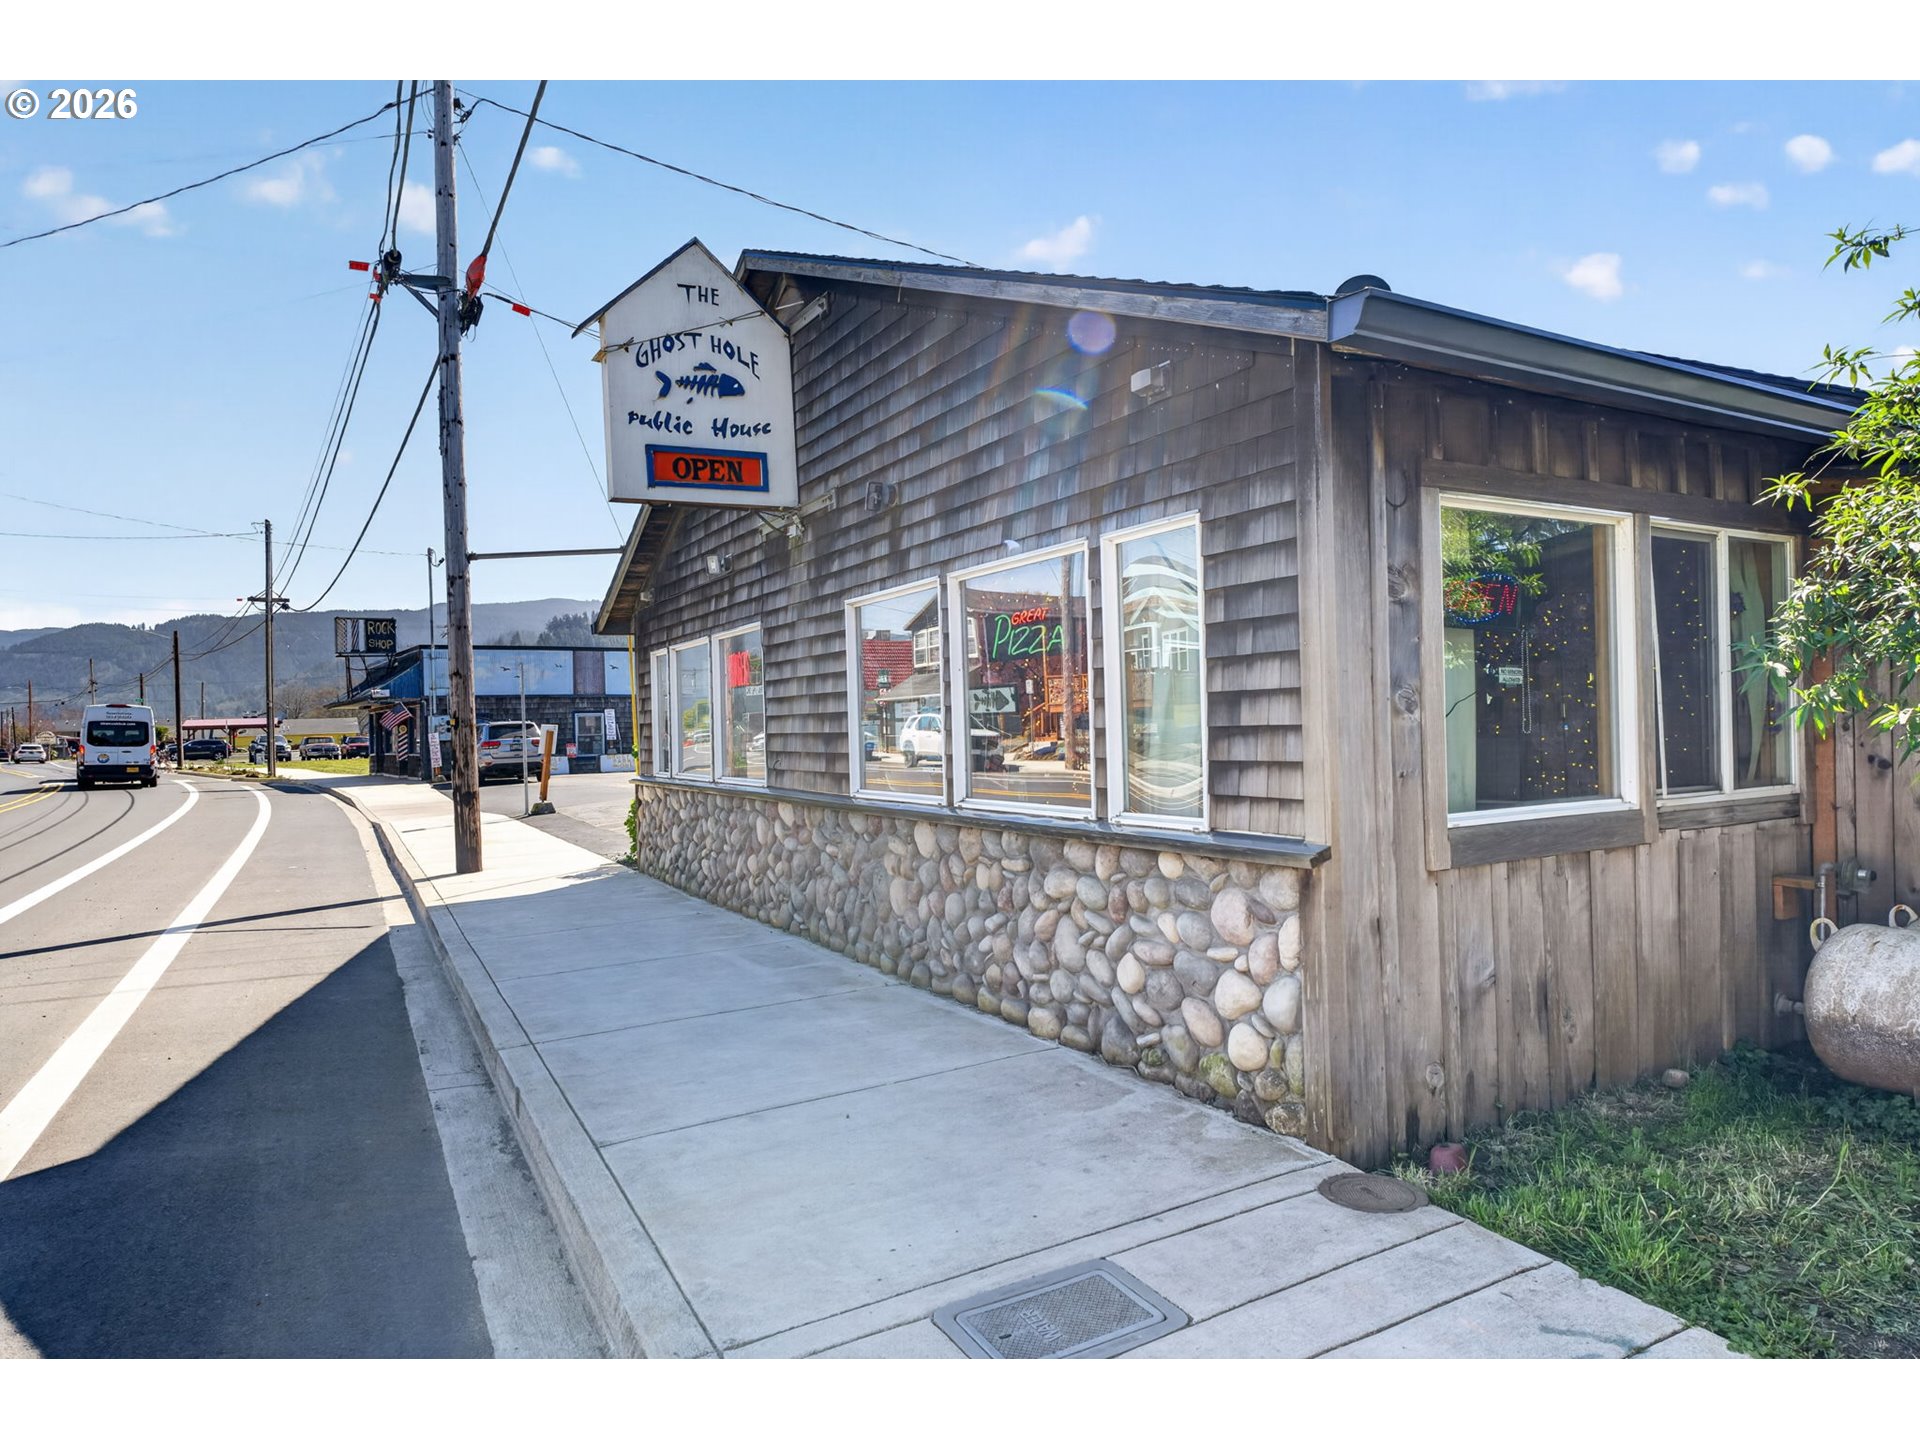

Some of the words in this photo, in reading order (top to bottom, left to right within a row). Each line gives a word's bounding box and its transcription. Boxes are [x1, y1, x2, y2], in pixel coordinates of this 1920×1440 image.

[677, 283, 720, 306] THE
[635, 333, 702, 368] GHOST
[711, 335, 760, 380] HOLE
[711, 417, 772, 439] House
[672, 456, 743, 483] OPEN
[1446, 581, 1519, 614] OPEN
[367, 621, 395, 635] ROCK
[1011, 607, 1049, 625] GREAT
[368, 639, 394, 649] SHOP
[992, 614, 1064, 658] PIZZA
[1018, 1306, 1064, 1342] WATER
